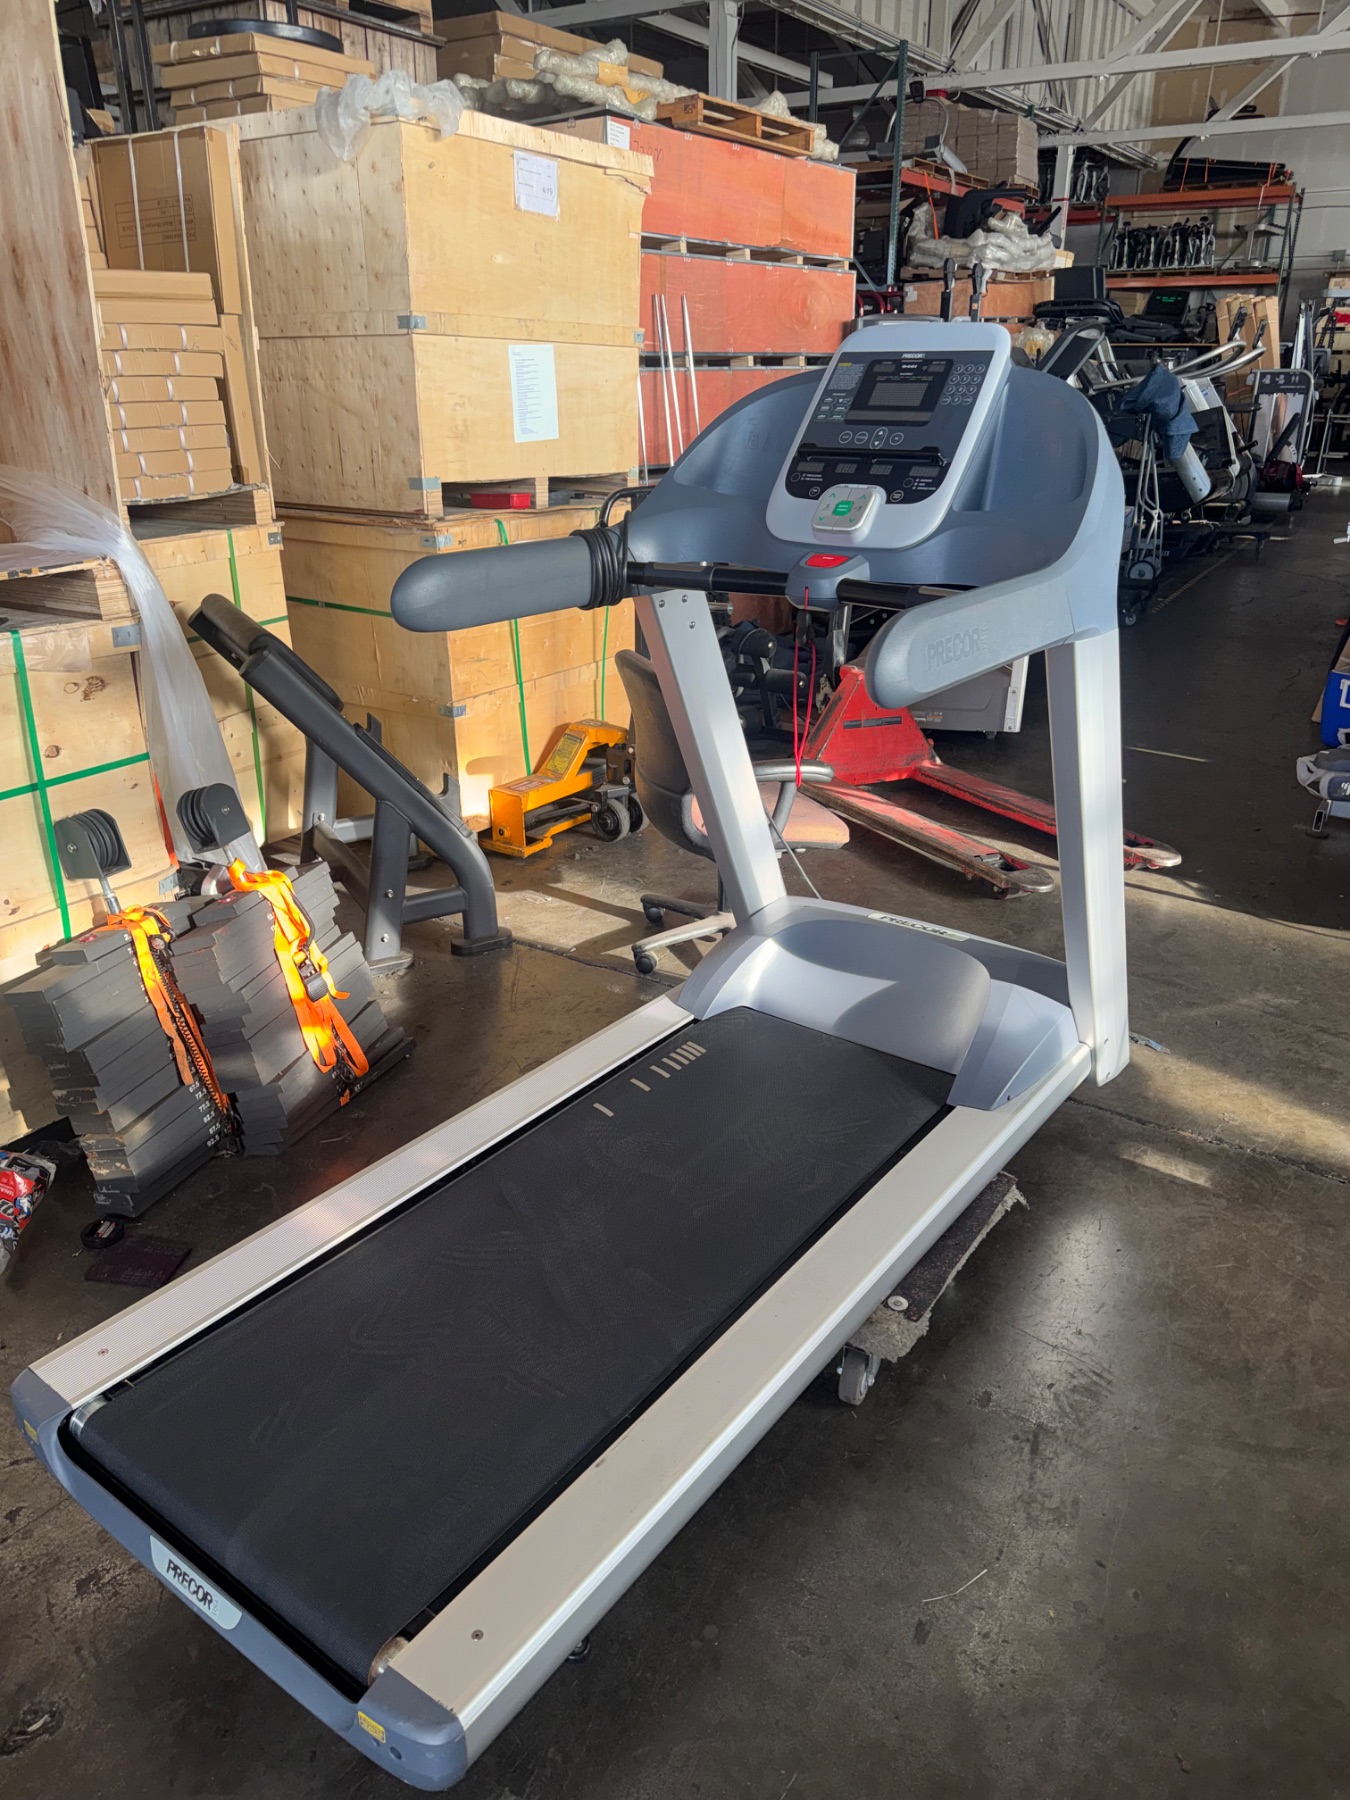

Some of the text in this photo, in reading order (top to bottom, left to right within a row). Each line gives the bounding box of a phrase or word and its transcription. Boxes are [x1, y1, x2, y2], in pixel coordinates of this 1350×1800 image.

[927, 627, 980, 669] PRECOR
[194, 1087, 208, 1101] 72.5
[198, 1100, 211, 1113] 77.5
[166, 1558, 213, 1611] PRECOR
